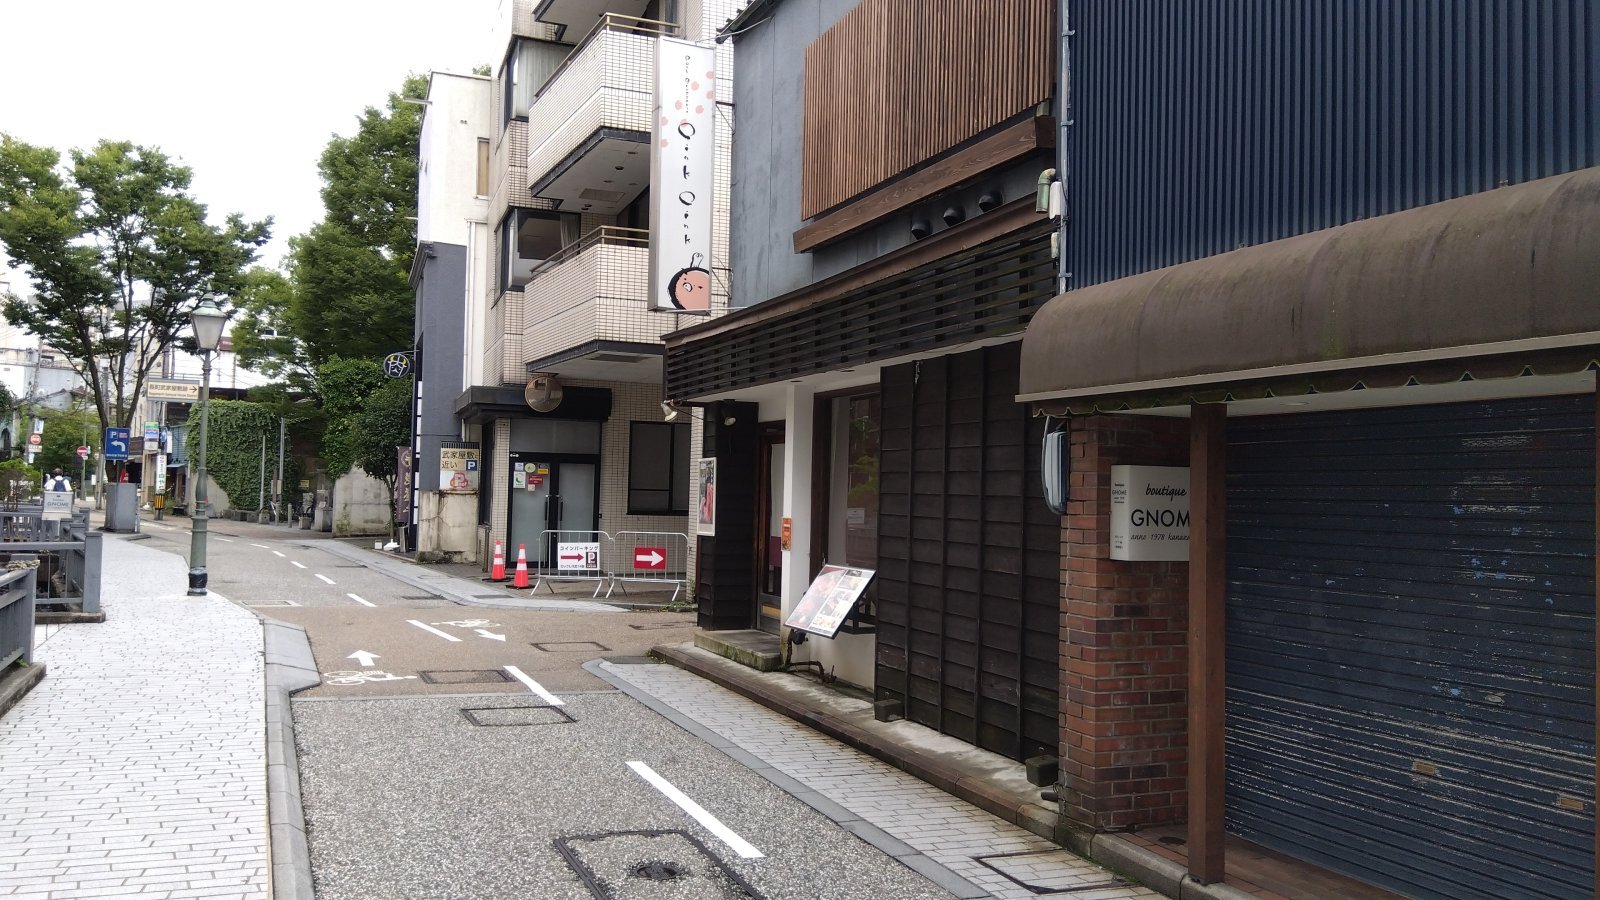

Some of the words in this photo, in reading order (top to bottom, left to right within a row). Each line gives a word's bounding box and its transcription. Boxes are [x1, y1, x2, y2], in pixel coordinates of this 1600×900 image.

[678, 122, 696, 179] Oink
[679, 191, 695, 244] Oink
[467, 461, 476, 470] P
[1145, 484, 1187, 501] boutique
[1151, 533, 1166, 541] 1978
